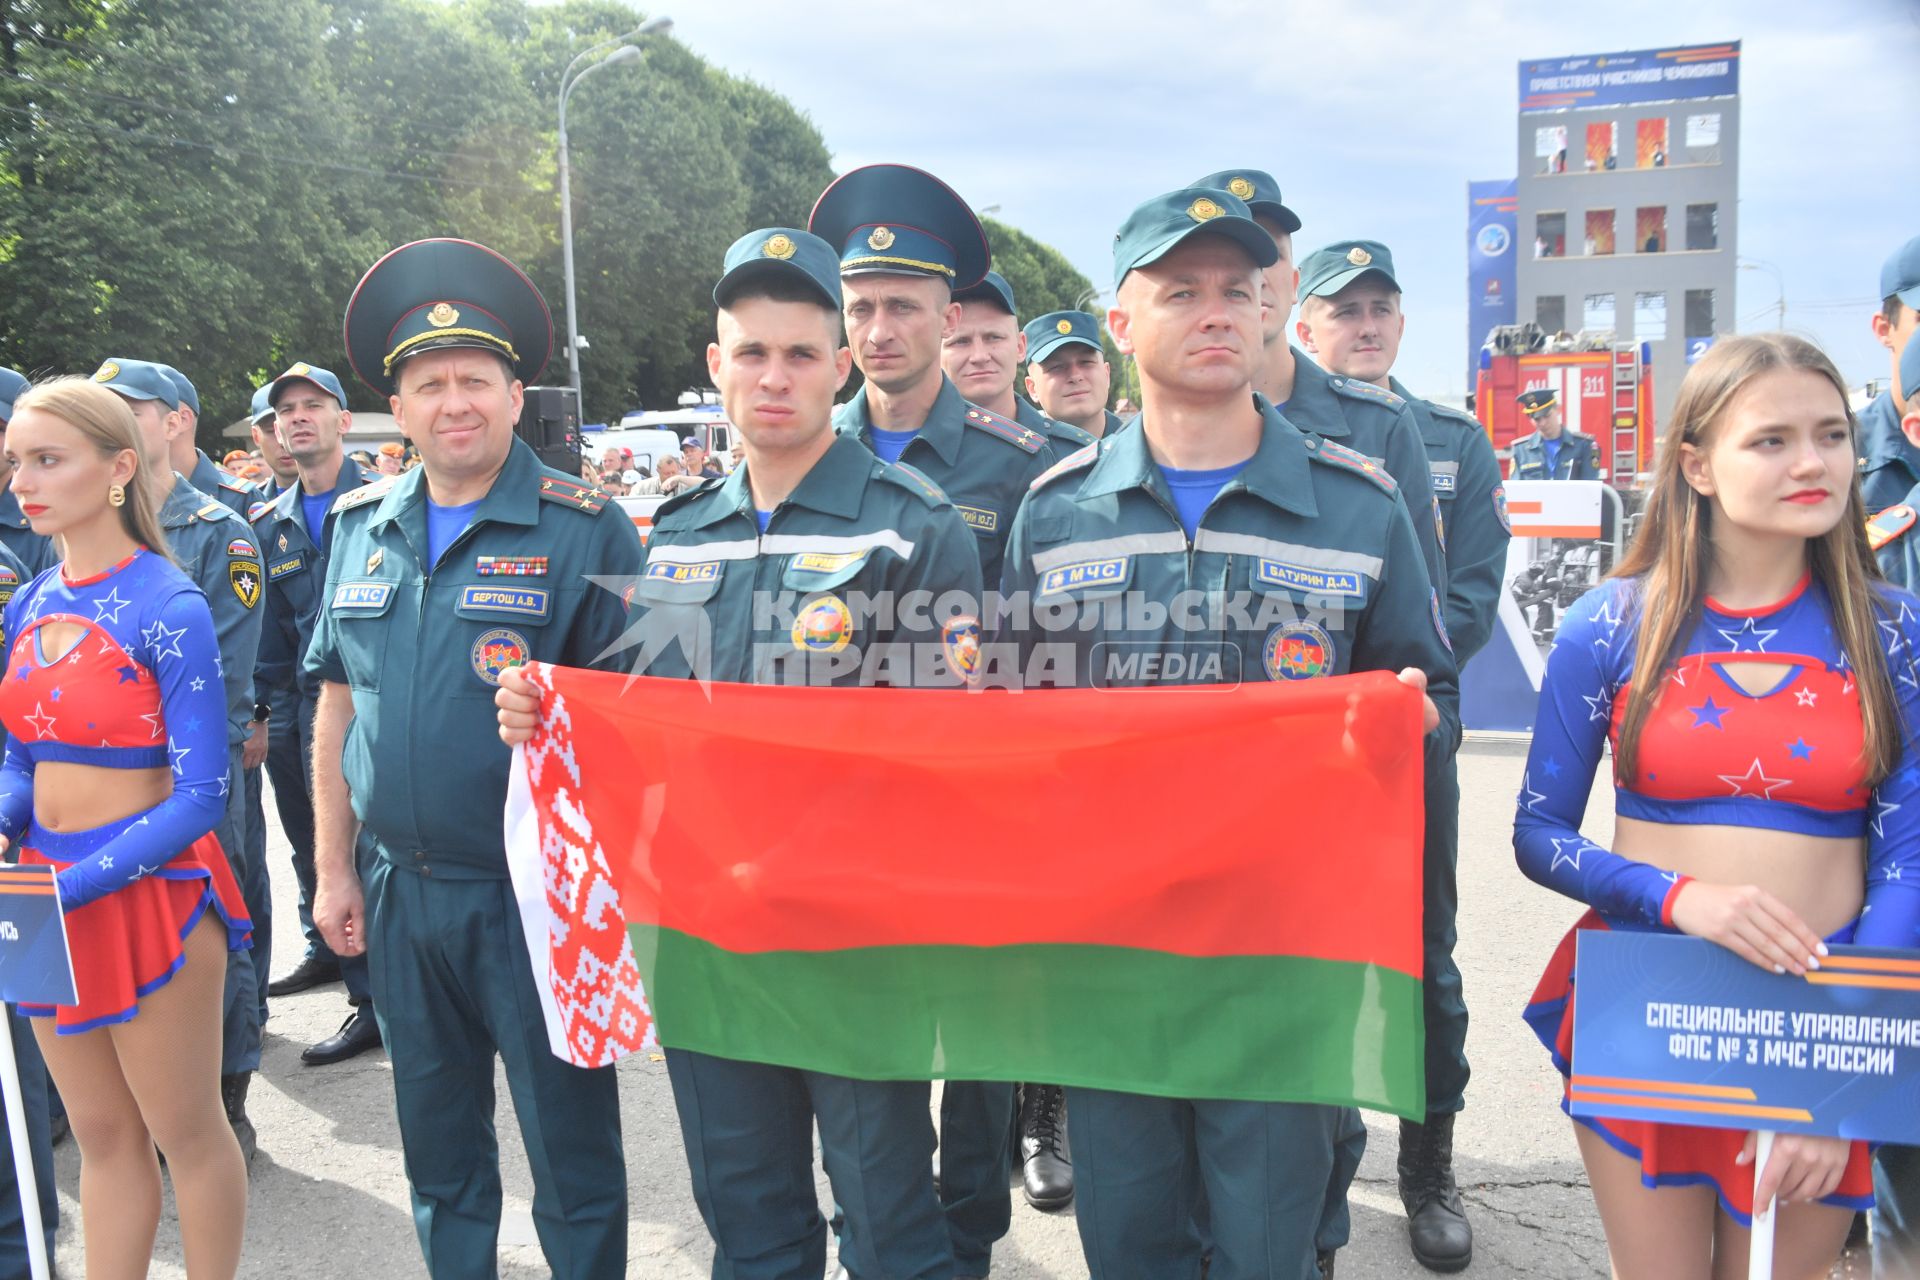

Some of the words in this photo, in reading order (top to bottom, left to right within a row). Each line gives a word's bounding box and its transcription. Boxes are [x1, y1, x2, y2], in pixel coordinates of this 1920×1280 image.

[1583, 376, 1604, 392] 311
[673, 565, 712, 580] МЧС
[1069, 564, 1116, 582] МЧС
[1270, 566, 1324, 586] БАТУРИН
[1326, 577, 1352, 588] Д.А.
[347, 588, 381, 601] МЧС
[473, 593, 515, 604] БЕРТОШ
[517, 596, 537, 607] А.В.
[1646, 1002, 1784, 1036] СПЕЦИАЛЬНОЕ
[1791, 1011, 1920, 1047] УПРАВЛЕНИЕ
[1669, 1033, 1711, 1060] ФПС
[1717, 1036, 1740, 1062] №
[1746, 1038, 1758, 1065] 3
[1764, 1040, 1807, 1068] МЧС
[1813, 1043, 1895, 1075] РОССИИ
